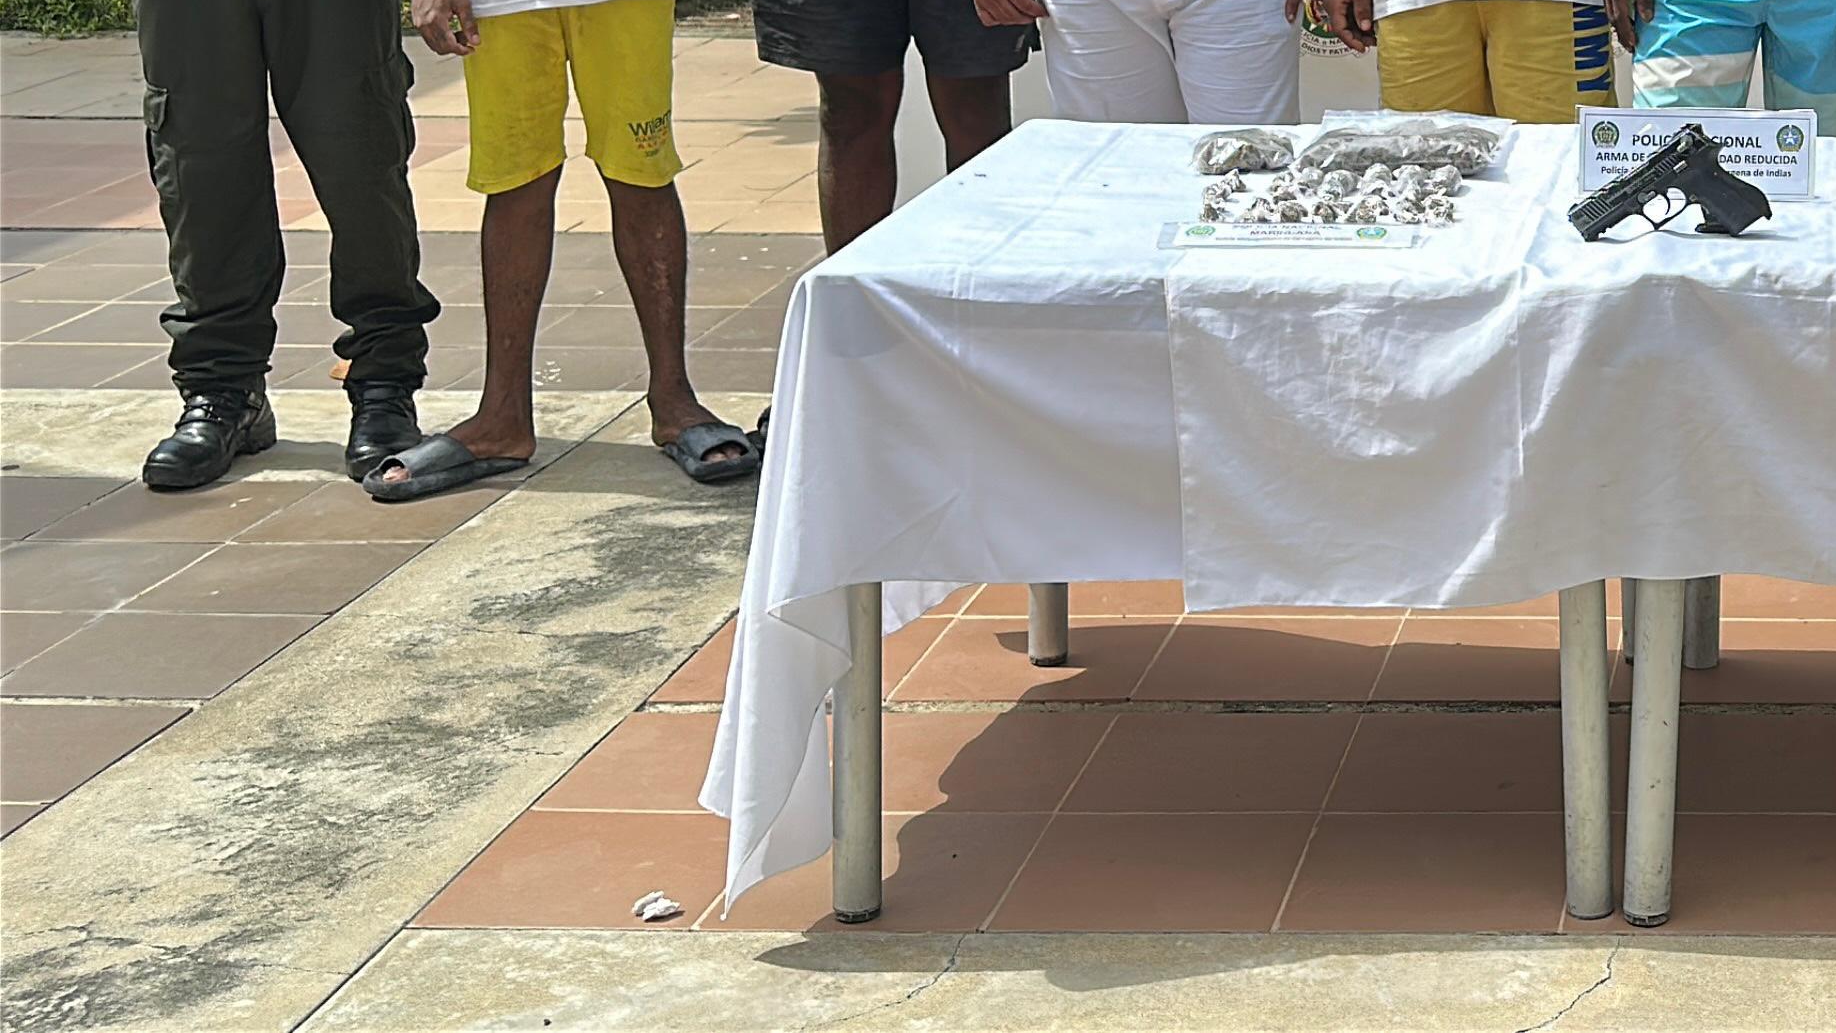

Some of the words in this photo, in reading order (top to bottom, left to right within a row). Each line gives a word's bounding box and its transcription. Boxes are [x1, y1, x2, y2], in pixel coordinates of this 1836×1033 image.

[1632, 134, 1673, 147] POLIC
[1596, 152, 1629, 162] ARMA
[1632, 152, 1646, 162] DE
[1744, 155, 1798, 165] REDUCIDA
[1753, 169, 1764, 177] de
